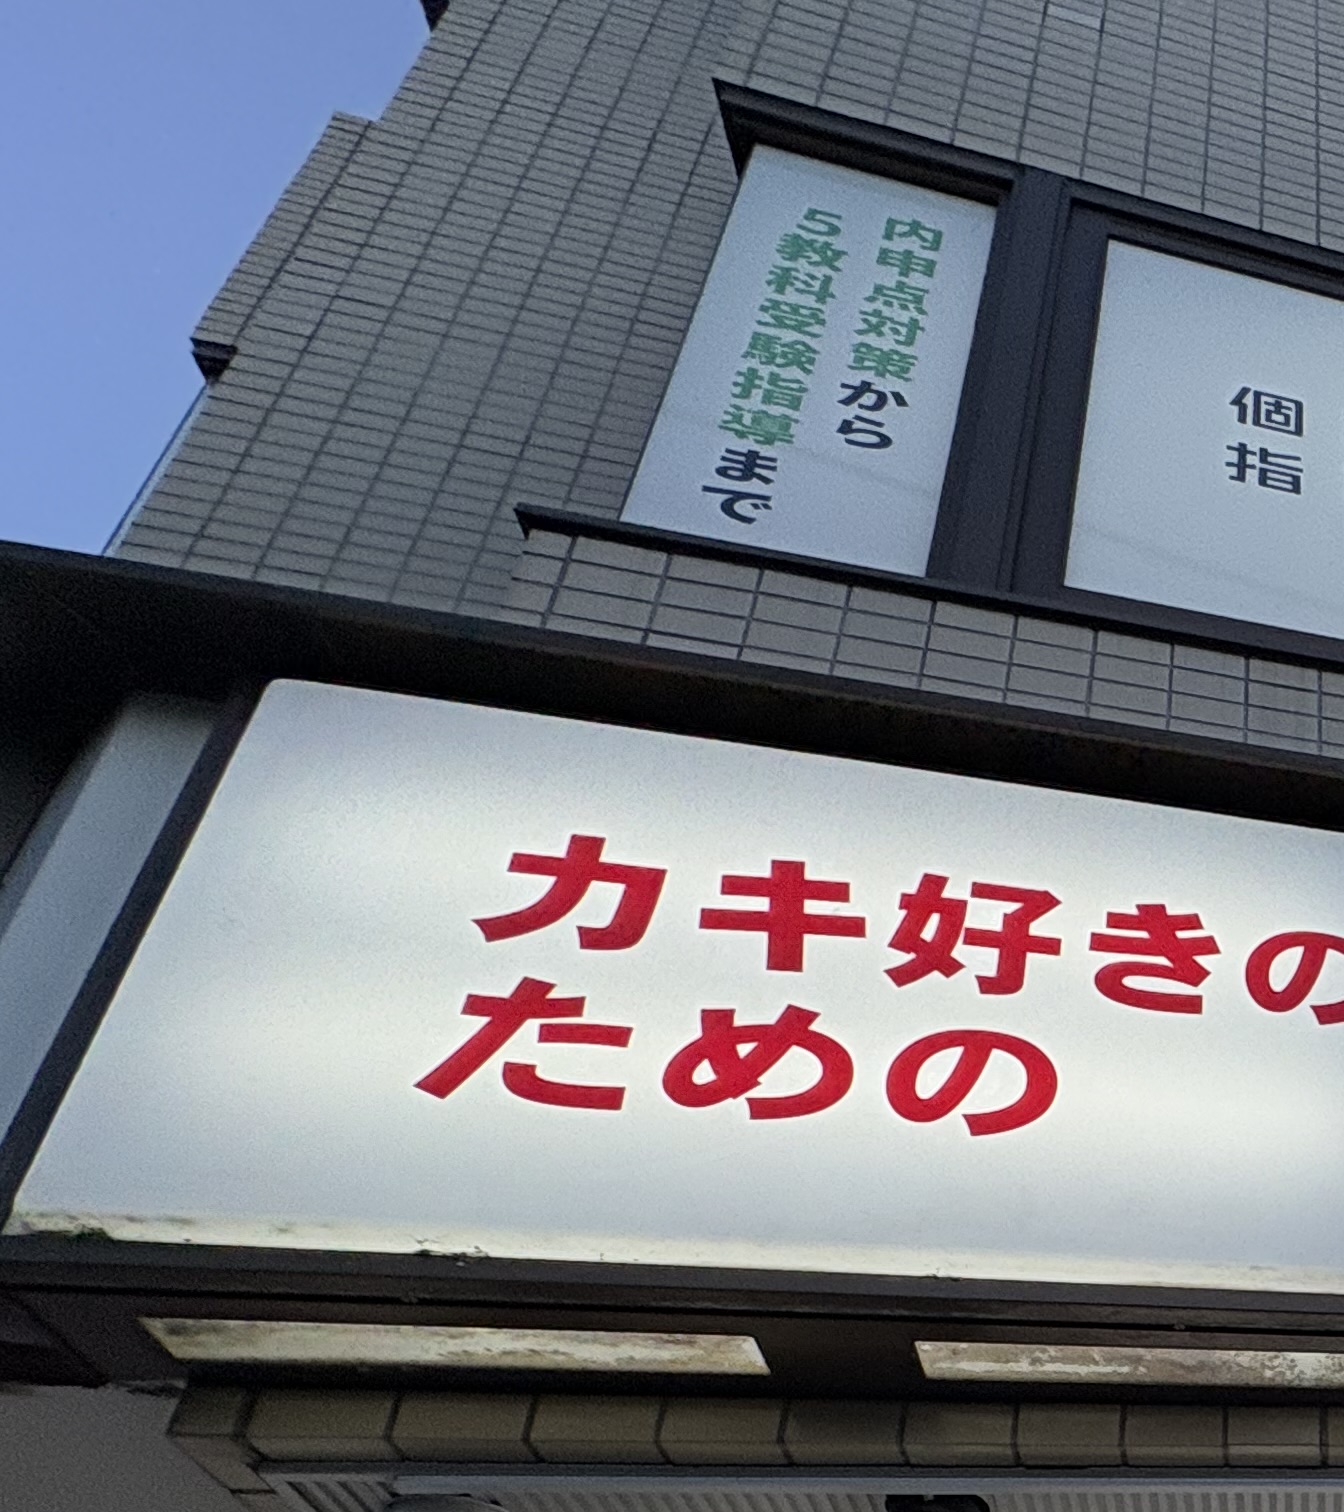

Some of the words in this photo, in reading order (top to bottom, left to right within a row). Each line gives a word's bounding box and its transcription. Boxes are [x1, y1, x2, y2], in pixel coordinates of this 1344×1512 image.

[701, 209, 848, 525] 5教科受験指導まで
[835, 216, 944, 450] 内申点対策から
[413, 975, 1058, 1137] ための
